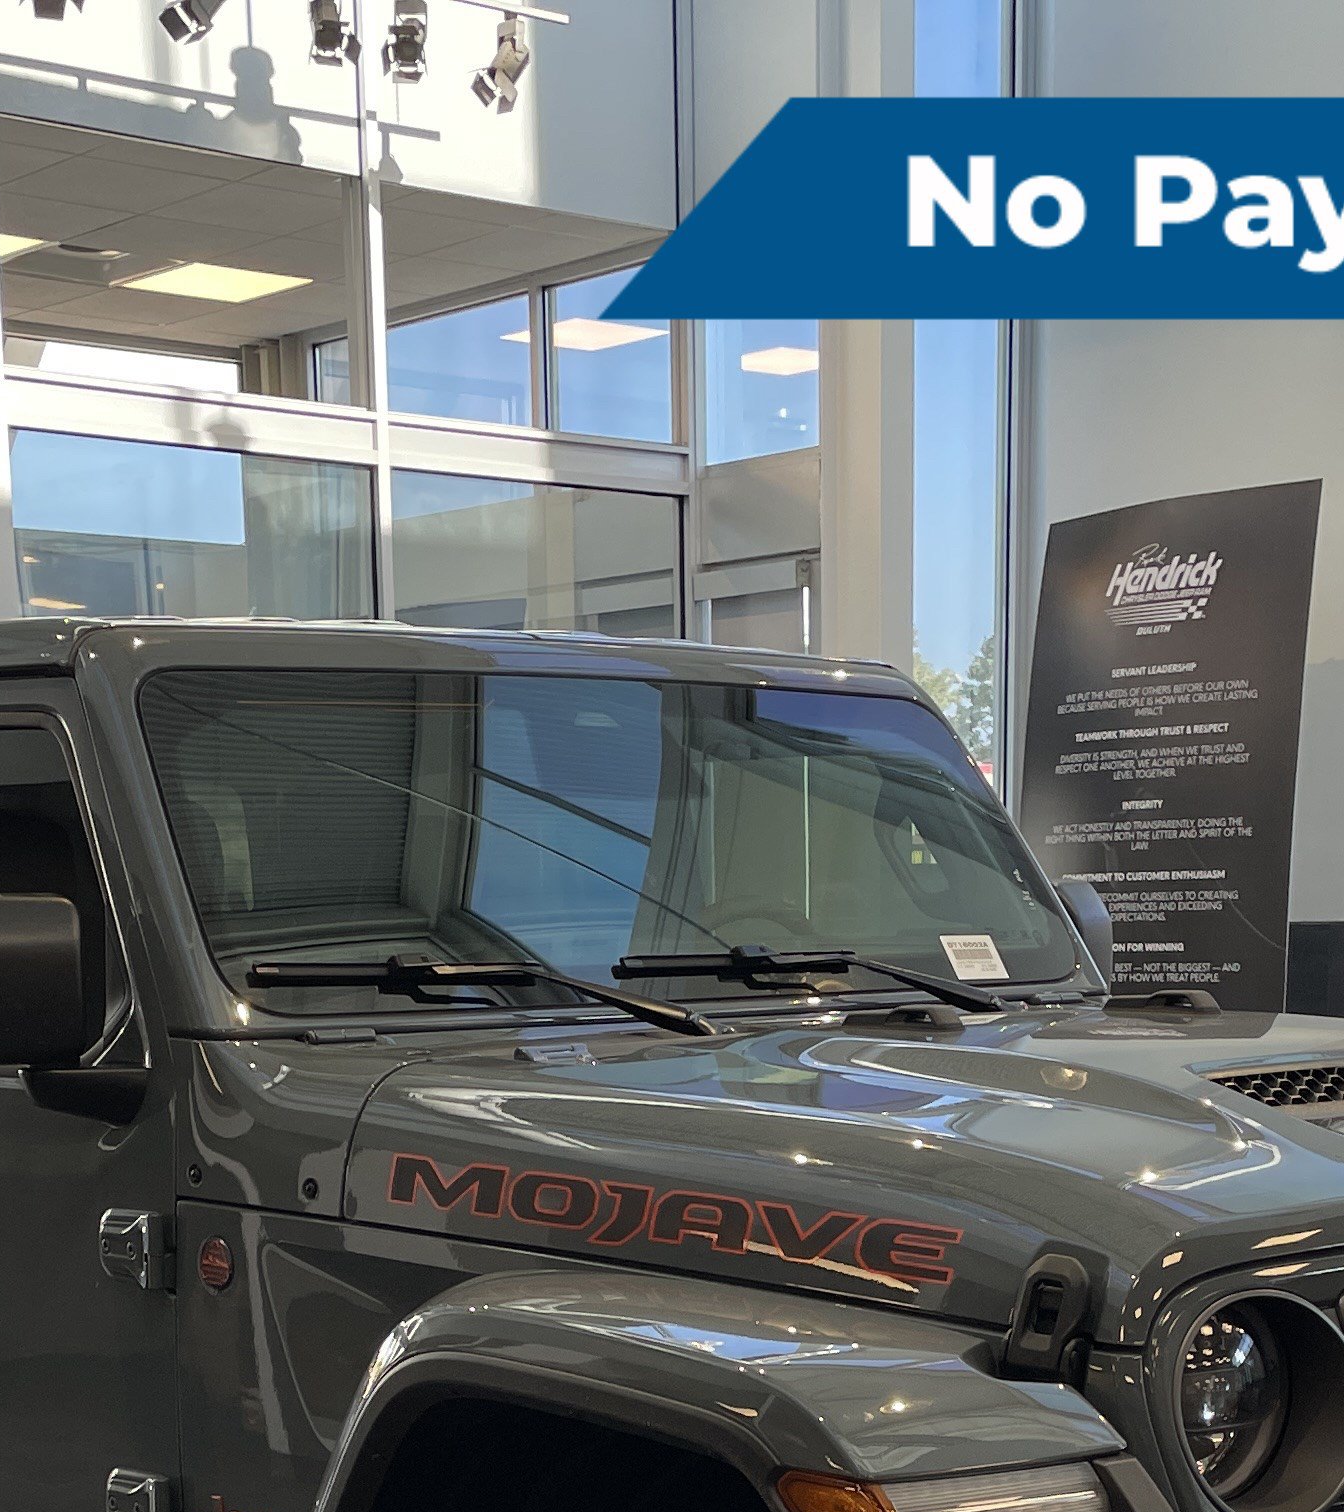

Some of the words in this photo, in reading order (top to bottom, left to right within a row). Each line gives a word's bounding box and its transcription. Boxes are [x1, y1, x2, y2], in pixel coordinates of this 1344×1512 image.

[1106, 551, 1223, 606] Hendrick
[1136, 624, 1172, 636] DULUTH
[1111, 666, 1146, 678] SERVANT
[1147, 662, 1197, 675] LEADERSHIP
[1091, 690, 1103, 701] THE
[1104, 688, 1128, 699] NEEDS
[1129, 687, 1140, 697] OF
[1141, 685, 1172, 696] OTHERS
[1173, 682, 1203, 693] BEFORE
[1205, 681, 1225, 691] OUR
[1226, 679, 1249, 690] OWN
[1057, 702, 1086, 715] BECAUSE
[1086, 700, 1117, 711] SERVING
[1118, 697, 1145, 708] PEOPLE
[1146, 697, 1154, 706] IS
[1154, 695, 1176, 706] HOW
[1178, 693, 1191, 703] WE
[1192, 691, 1223, 702] CREATE
[1224, 689, 1258, 700] LASTING
[1075, 730, 1118, 743] TEAMWORK
[1118, 728, 1159, 739] THROUGH
[1160, 725, 1185, 736] TRUST
[1186, 724, 1192, 735] &
[1193, 722, 1229, 734] RESPECT
[1060, 752, 1092, 764] DIVERSITY
[1140, 748, 1158, 758] AND
[1159, 746, 1184, 757] WHEN
[1185, 745, 1199, 755] WE
[1201, 743, 1225, 754] TRUST
[1226, 742, 1245, 753] AND
[1055, 763, 1082, 774] RESPECT
[1082, 762, 1099, 772] ONE
[1137, 758, 1151, 768] WE
[1152, 756, 1185, 768] ACHIEVE
[1186, 755, 1197, 765] AT
[1199, 755, 1213, 765] THE
[1215, 752, 1250, 764] HIGHEST
[1113, 770, 1134, 781] LEVEL
[1122, 799, 1163, 810] INTEGRITY
[1064, 823, 1077, 833] ACT
[1078, 822, 1114, 833] HONESTLY
[1115, 821, 1132, 831] AND
[1197, 817, 1227, 828] DOING
[1228, 816, 1243, 826] THE
[1087, 832, 1113, 842] WITHIN
[1114, 831, 1135, 841] BOTH
[1136, 831, 1150, 841] THE
[1152, 829, 1177, 840] LETTER
[1179, 828, 1197, 838] AND
[1198, 828, 1222, 838] SPIRIT
[1223, 827, 1236, 837] OF
[1237, 827, 1253, 837] THE
[1114, 872, 1125, 881] TO
[1125, 871, 1170, 881] CUSTOMER
[1171, 869, 1226, 880] ENTHUSIASM
[1140, 891, 1183, 902] OURSELVES
[1185, 890, 1197, 901] TO
[1198, 889, 1239, 900] CREATING
[1109, 901, 1157, 912] EXPERIENCES
[1158, 901, 1176, 911] AND
[1177, 901, 1223, 911] EXCEEDING
[1111, 943, 1126, 952] ON
[1127, 943, 1144, 952] FOR
[1144, 942, 1184, 952] WINNING
[1114, 963, 1132, 973] BEST
[1143, 963, 1160, 972] NOT
[1162, 963, 1176, 972] THE
[1177, 963, 1211, 973] BIGGEST
[1221, 963, 1241, 972] AND
[1117, 973, 1128, 982] BY
[1129, 973, 1150, 982] HOW
[1151, 973, 1165, 982] WE
[1166, 973, 1189, 983] TREAT
[387, 1152, 965, 1285] MOJAVE
